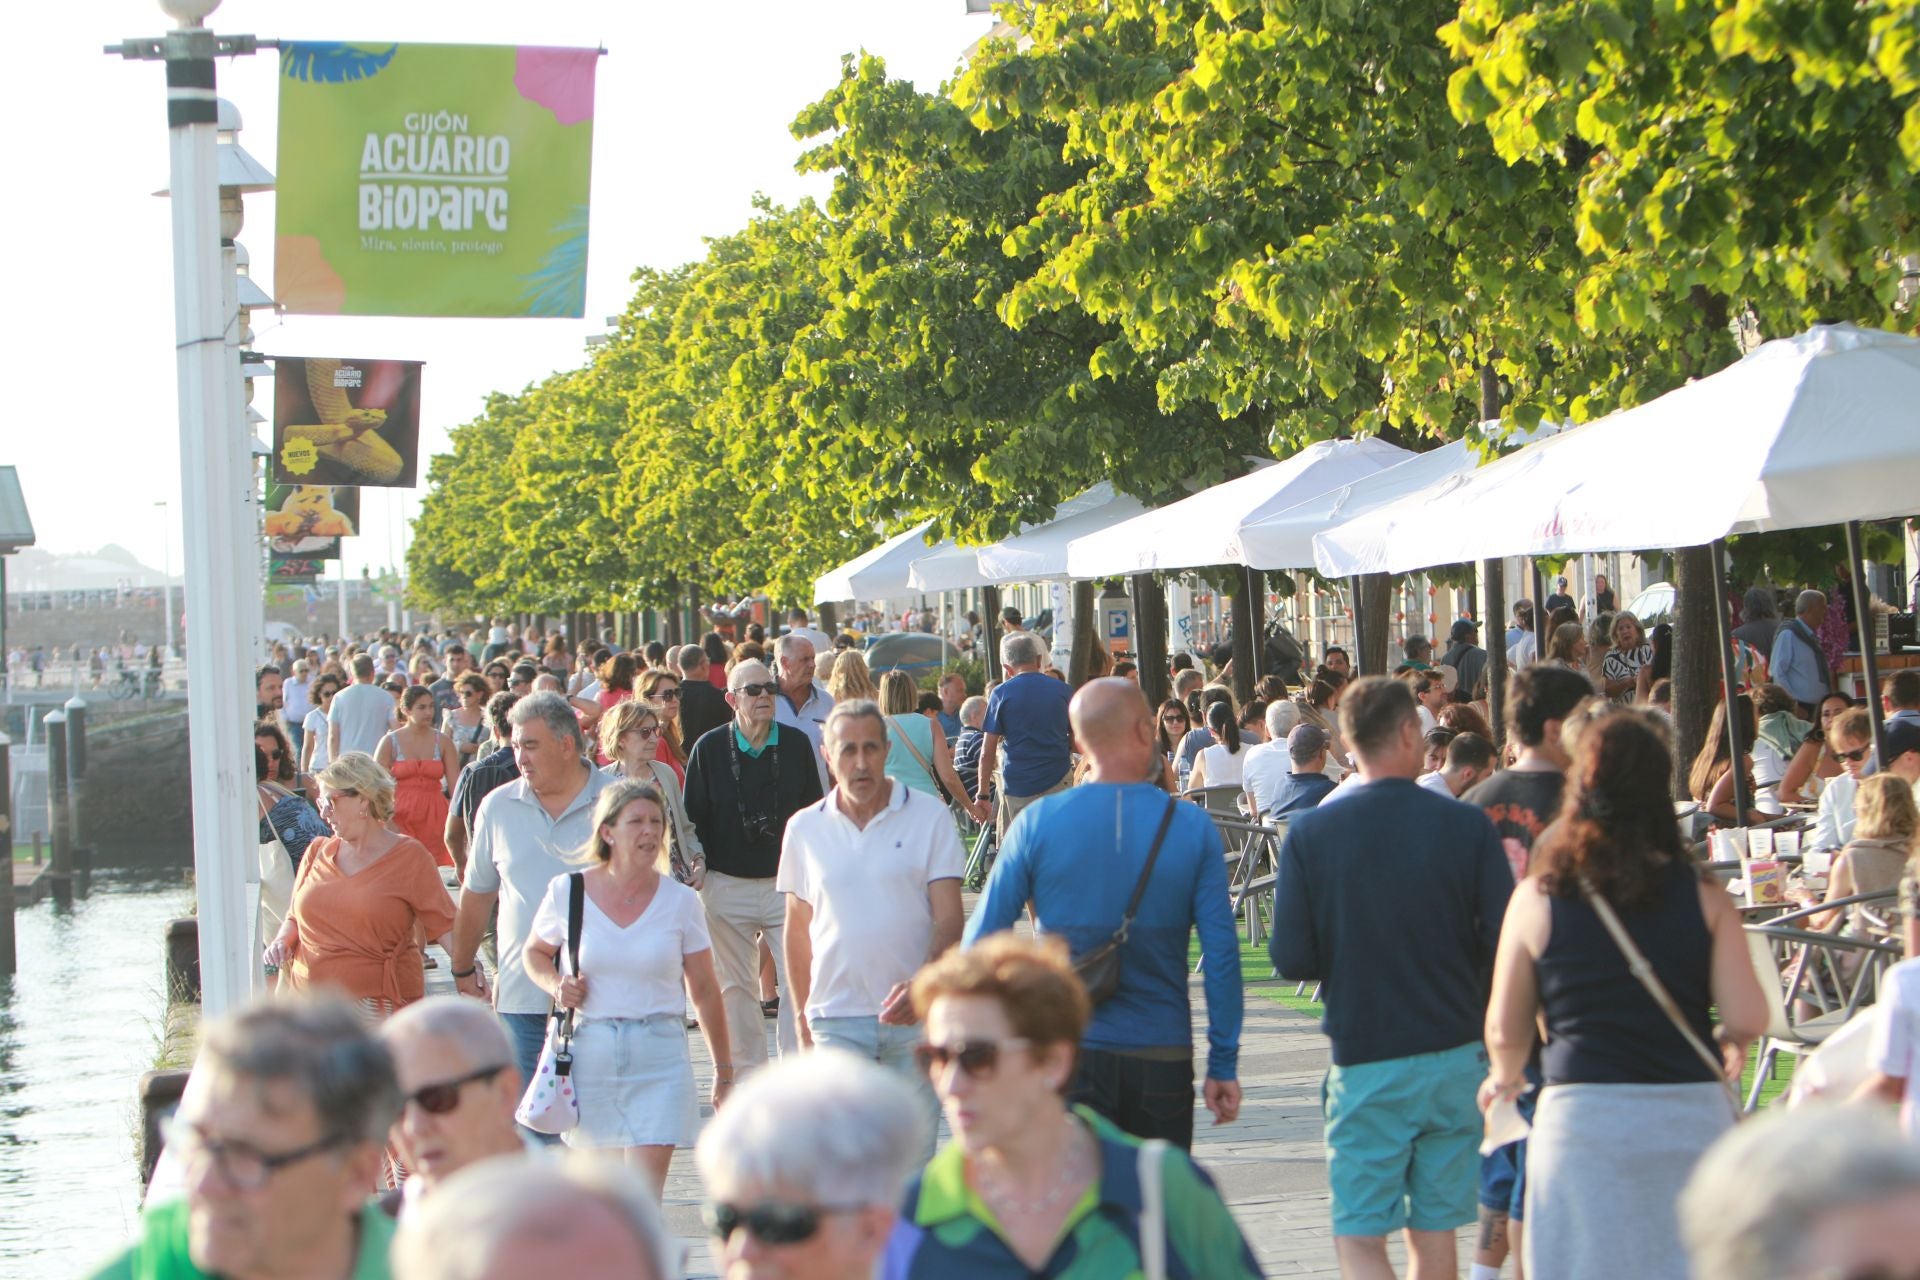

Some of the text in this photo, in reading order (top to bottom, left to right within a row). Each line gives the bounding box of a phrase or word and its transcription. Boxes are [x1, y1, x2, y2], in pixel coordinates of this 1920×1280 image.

[404, 109, 468, 135] GIJÓN
[359, 132, 511, 175] ACUARIO
[1110, 613, 1127, 635] P
